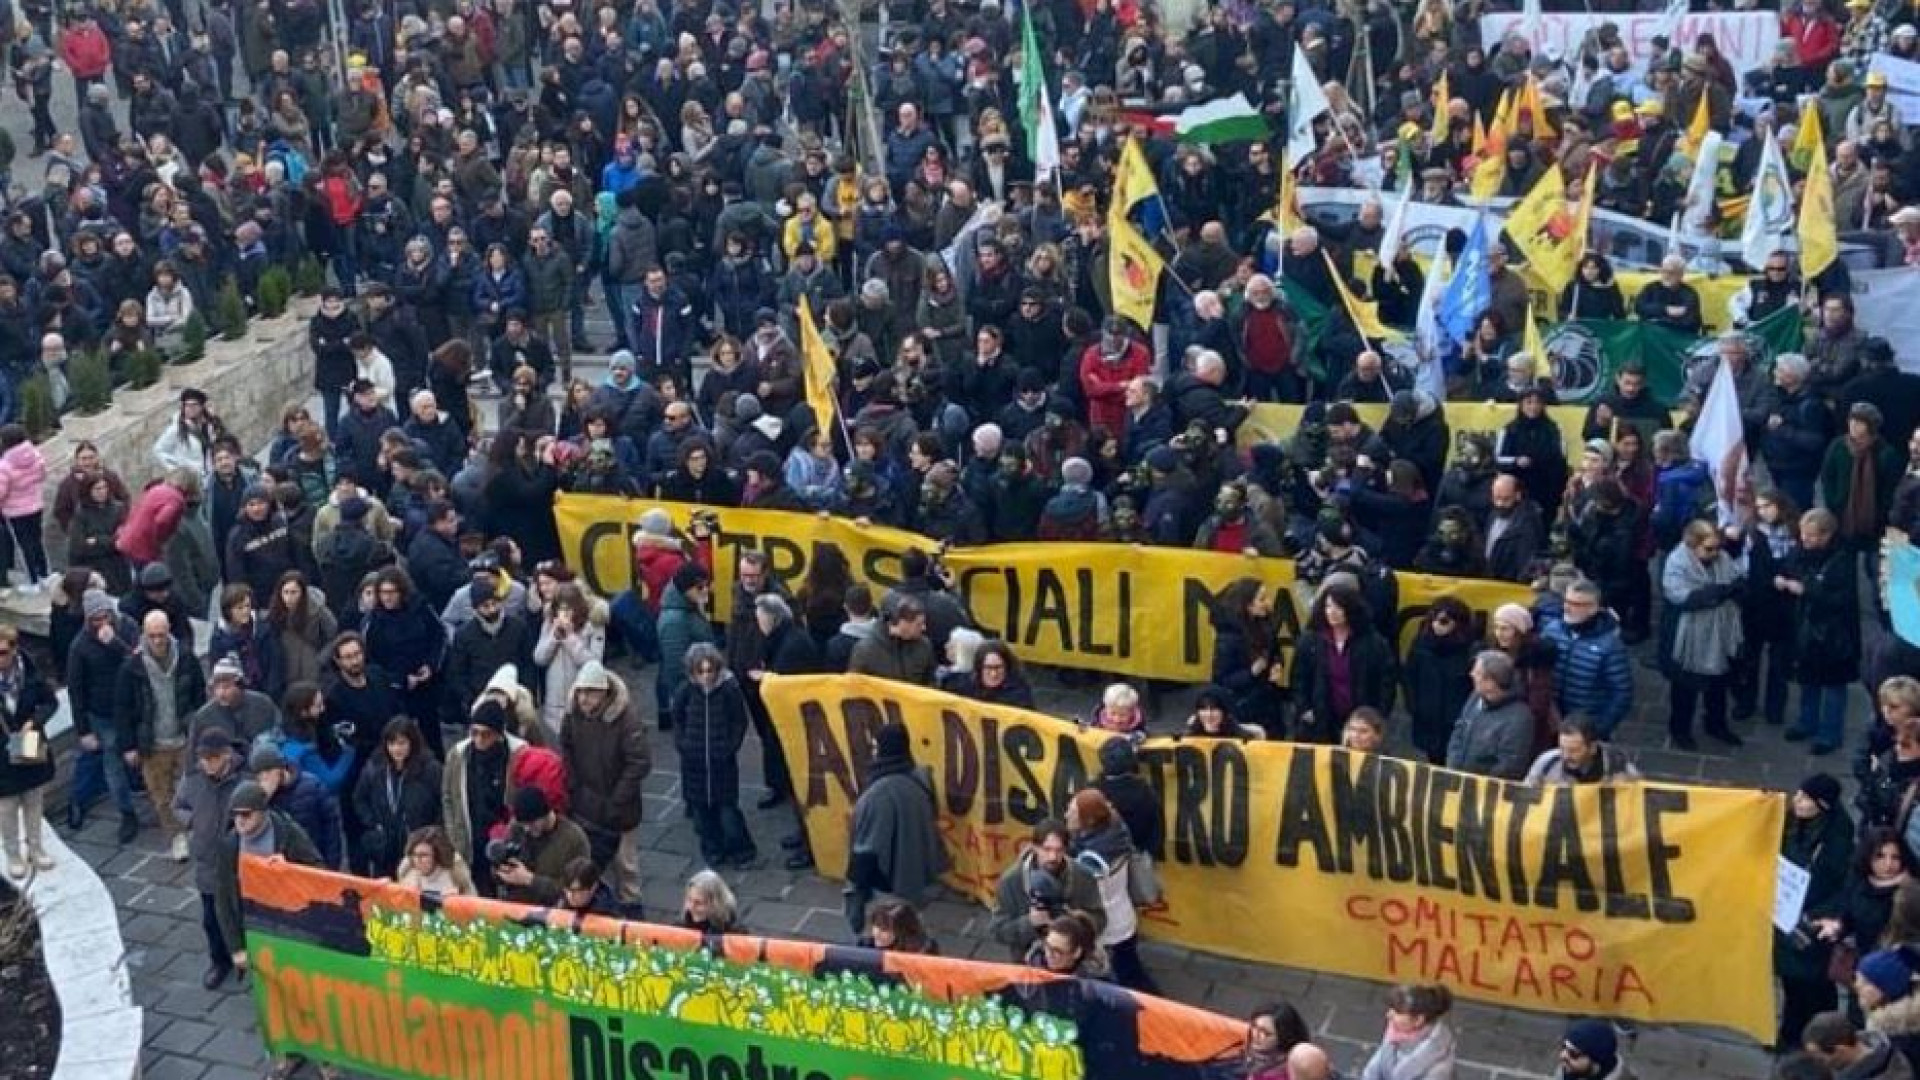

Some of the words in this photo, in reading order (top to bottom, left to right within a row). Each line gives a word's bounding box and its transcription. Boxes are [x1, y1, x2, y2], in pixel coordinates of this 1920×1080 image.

[941, 709, 1249, 868] DISATRO
[1276, 744, 1696, 923] AMBIENTALE
[1346, 894, 1597, 961] COMITATO
[1386, 932, 1656, 1006] MALARIA
